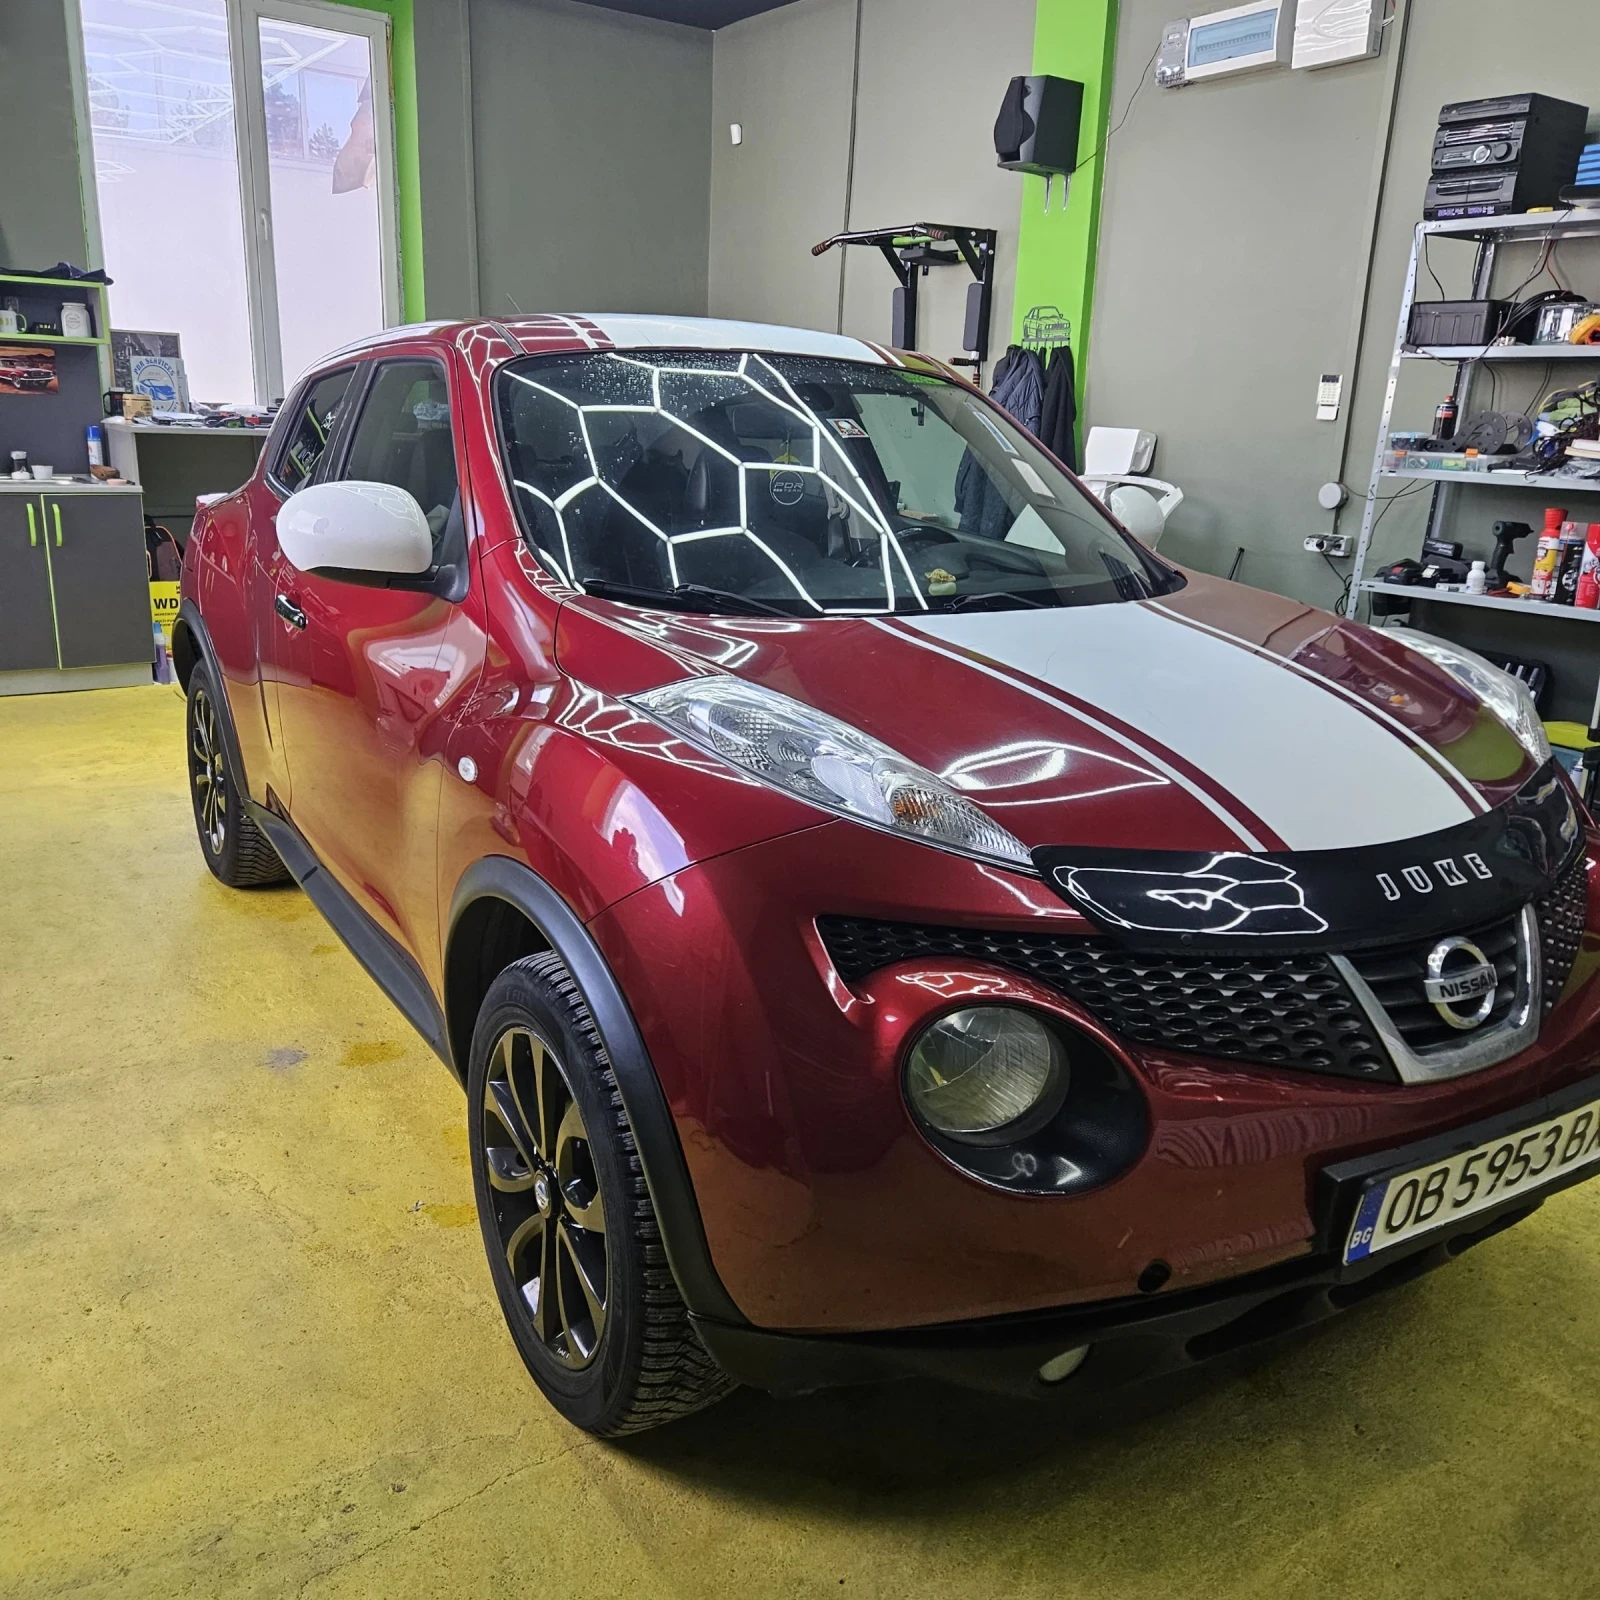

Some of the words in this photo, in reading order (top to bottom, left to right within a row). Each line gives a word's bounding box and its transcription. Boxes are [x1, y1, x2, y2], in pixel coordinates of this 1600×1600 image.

[145, 357, 176, 377] SERVICES
[774, 481, 804, 489] PDR
[153, 597, 179, 609] WD
[1375, 853, 1493, 901] JUKE
[1440, 970, 1496, 998] NISSAN
[1386, 1166, 1450, 1234] OB
[1452, 1124, 1563, 1208] 5953
[1350, 1227, 1373, 1250] BG
